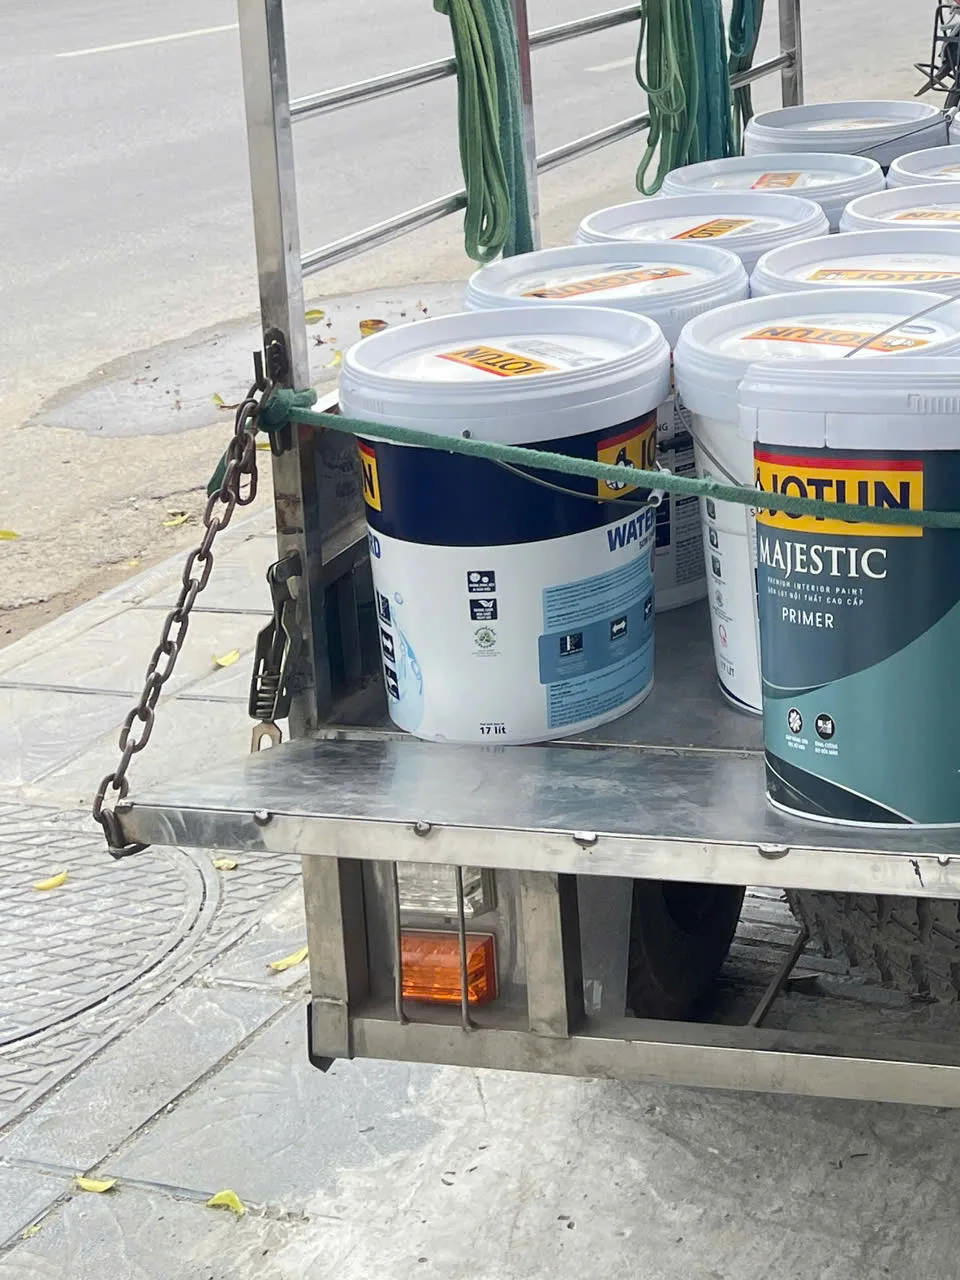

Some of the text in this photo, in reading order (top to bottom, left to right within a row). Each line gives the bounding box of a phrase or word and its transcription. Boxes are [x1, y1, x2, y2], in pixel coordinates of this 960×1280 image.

[460, 347, 540, 375] JOTUN
[759, 535, 888, 579] MAJESTIC
[793, 582, 831, 594] INTERIOR
[835, 587, 864, 595] PAINT
[826, 596, 843, 605] CAO
[782, 606, 834, 628] PRIMER
[480, 726, 492, 735] 17
